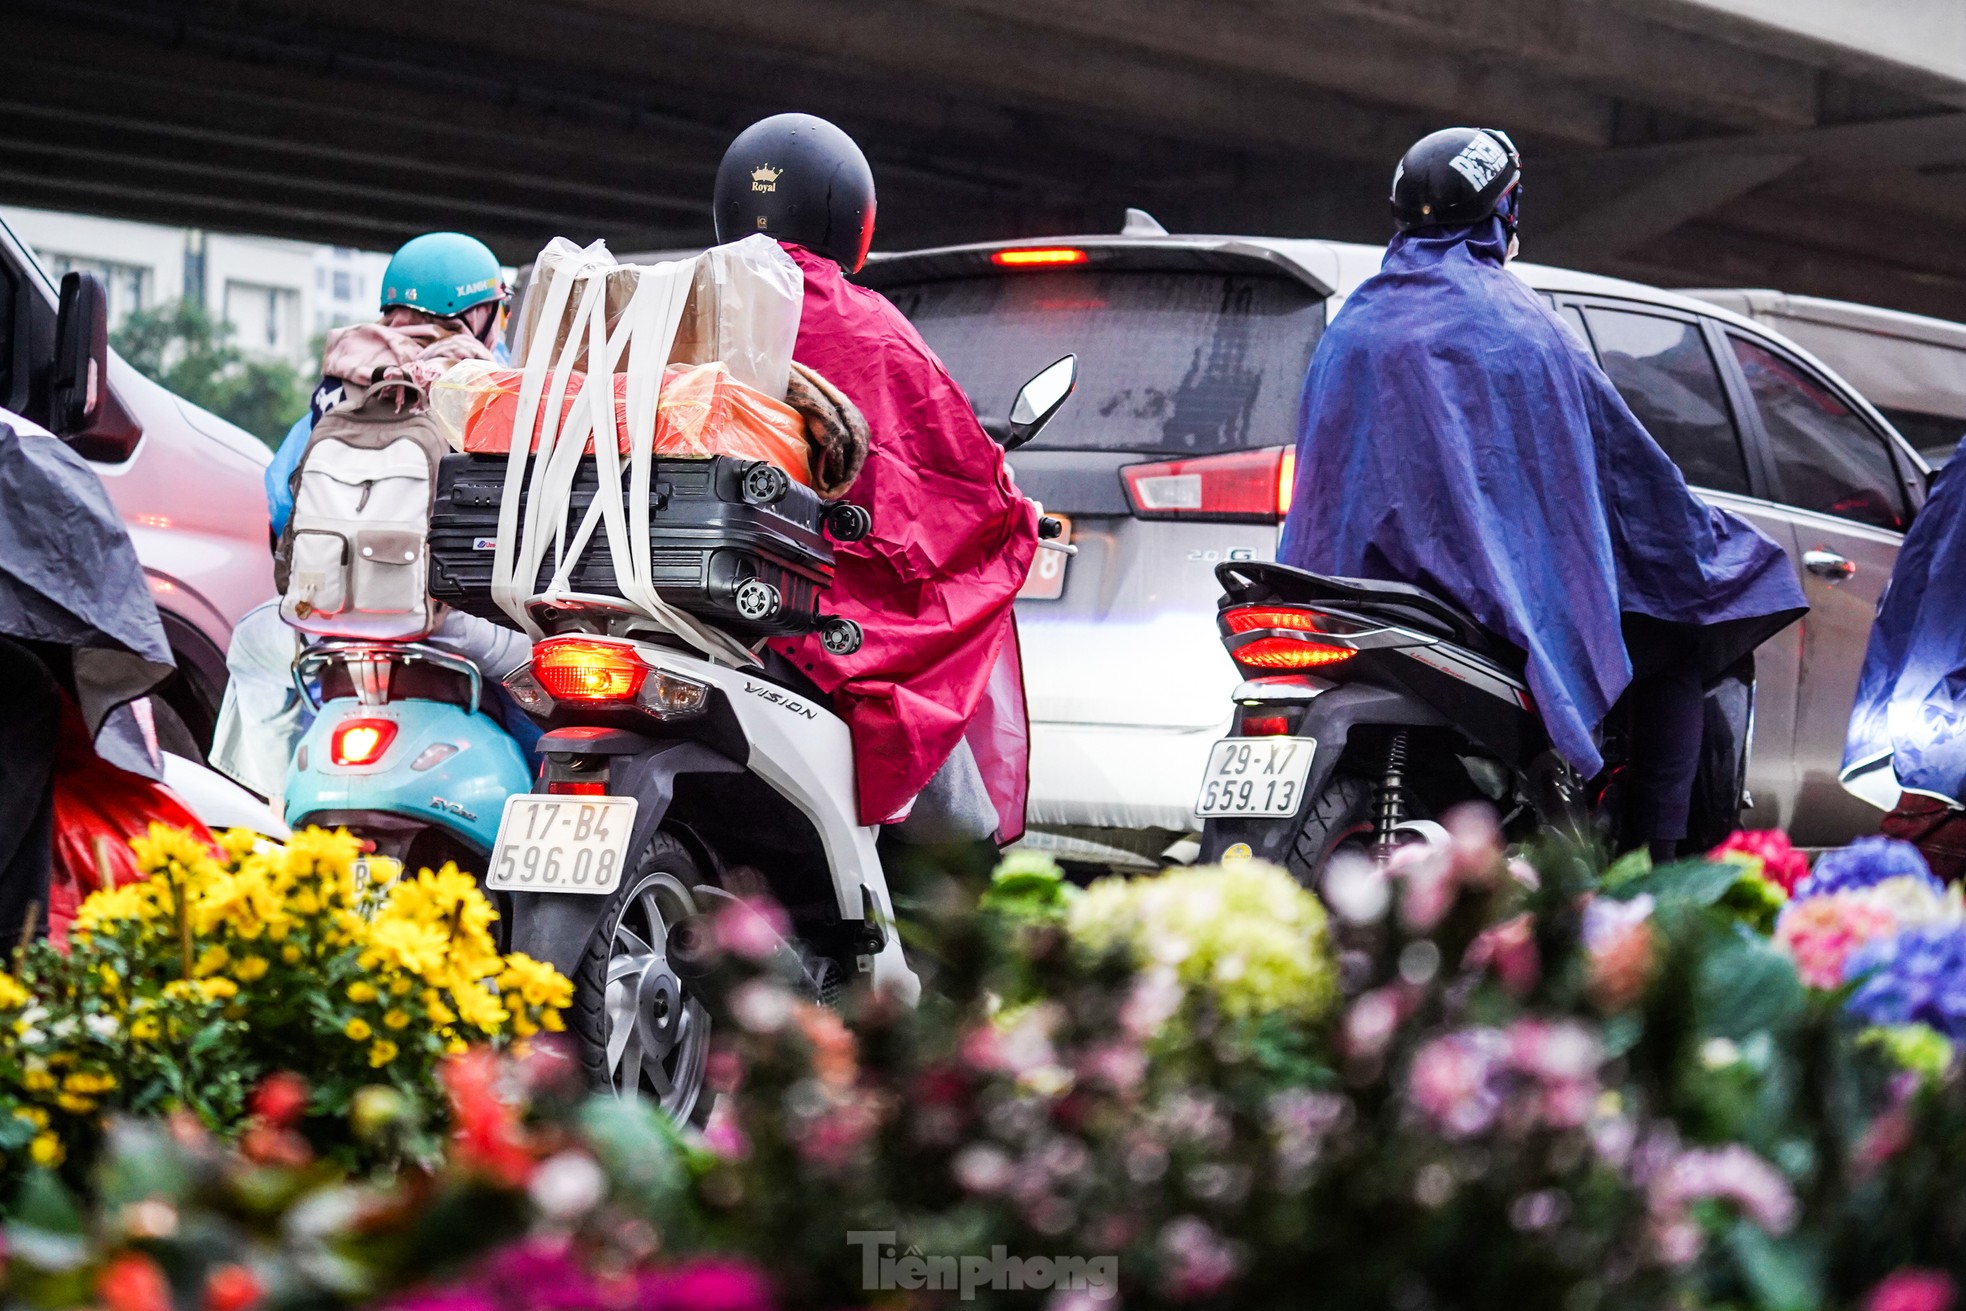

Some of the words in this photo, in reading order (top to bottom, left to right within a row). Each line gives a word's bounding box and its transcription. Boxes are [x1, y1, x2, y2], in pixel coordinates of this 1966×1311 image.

[752, 181, 776, 193] Royal
[743, 681, 818, 720] VISION
[1219, 743, 1298, 775] 29-X7
[1203, 779, 1296, 812] 659.13
[525, 803, 610, 842] 17-B4
[498, 844, 617, 885] 596.08
